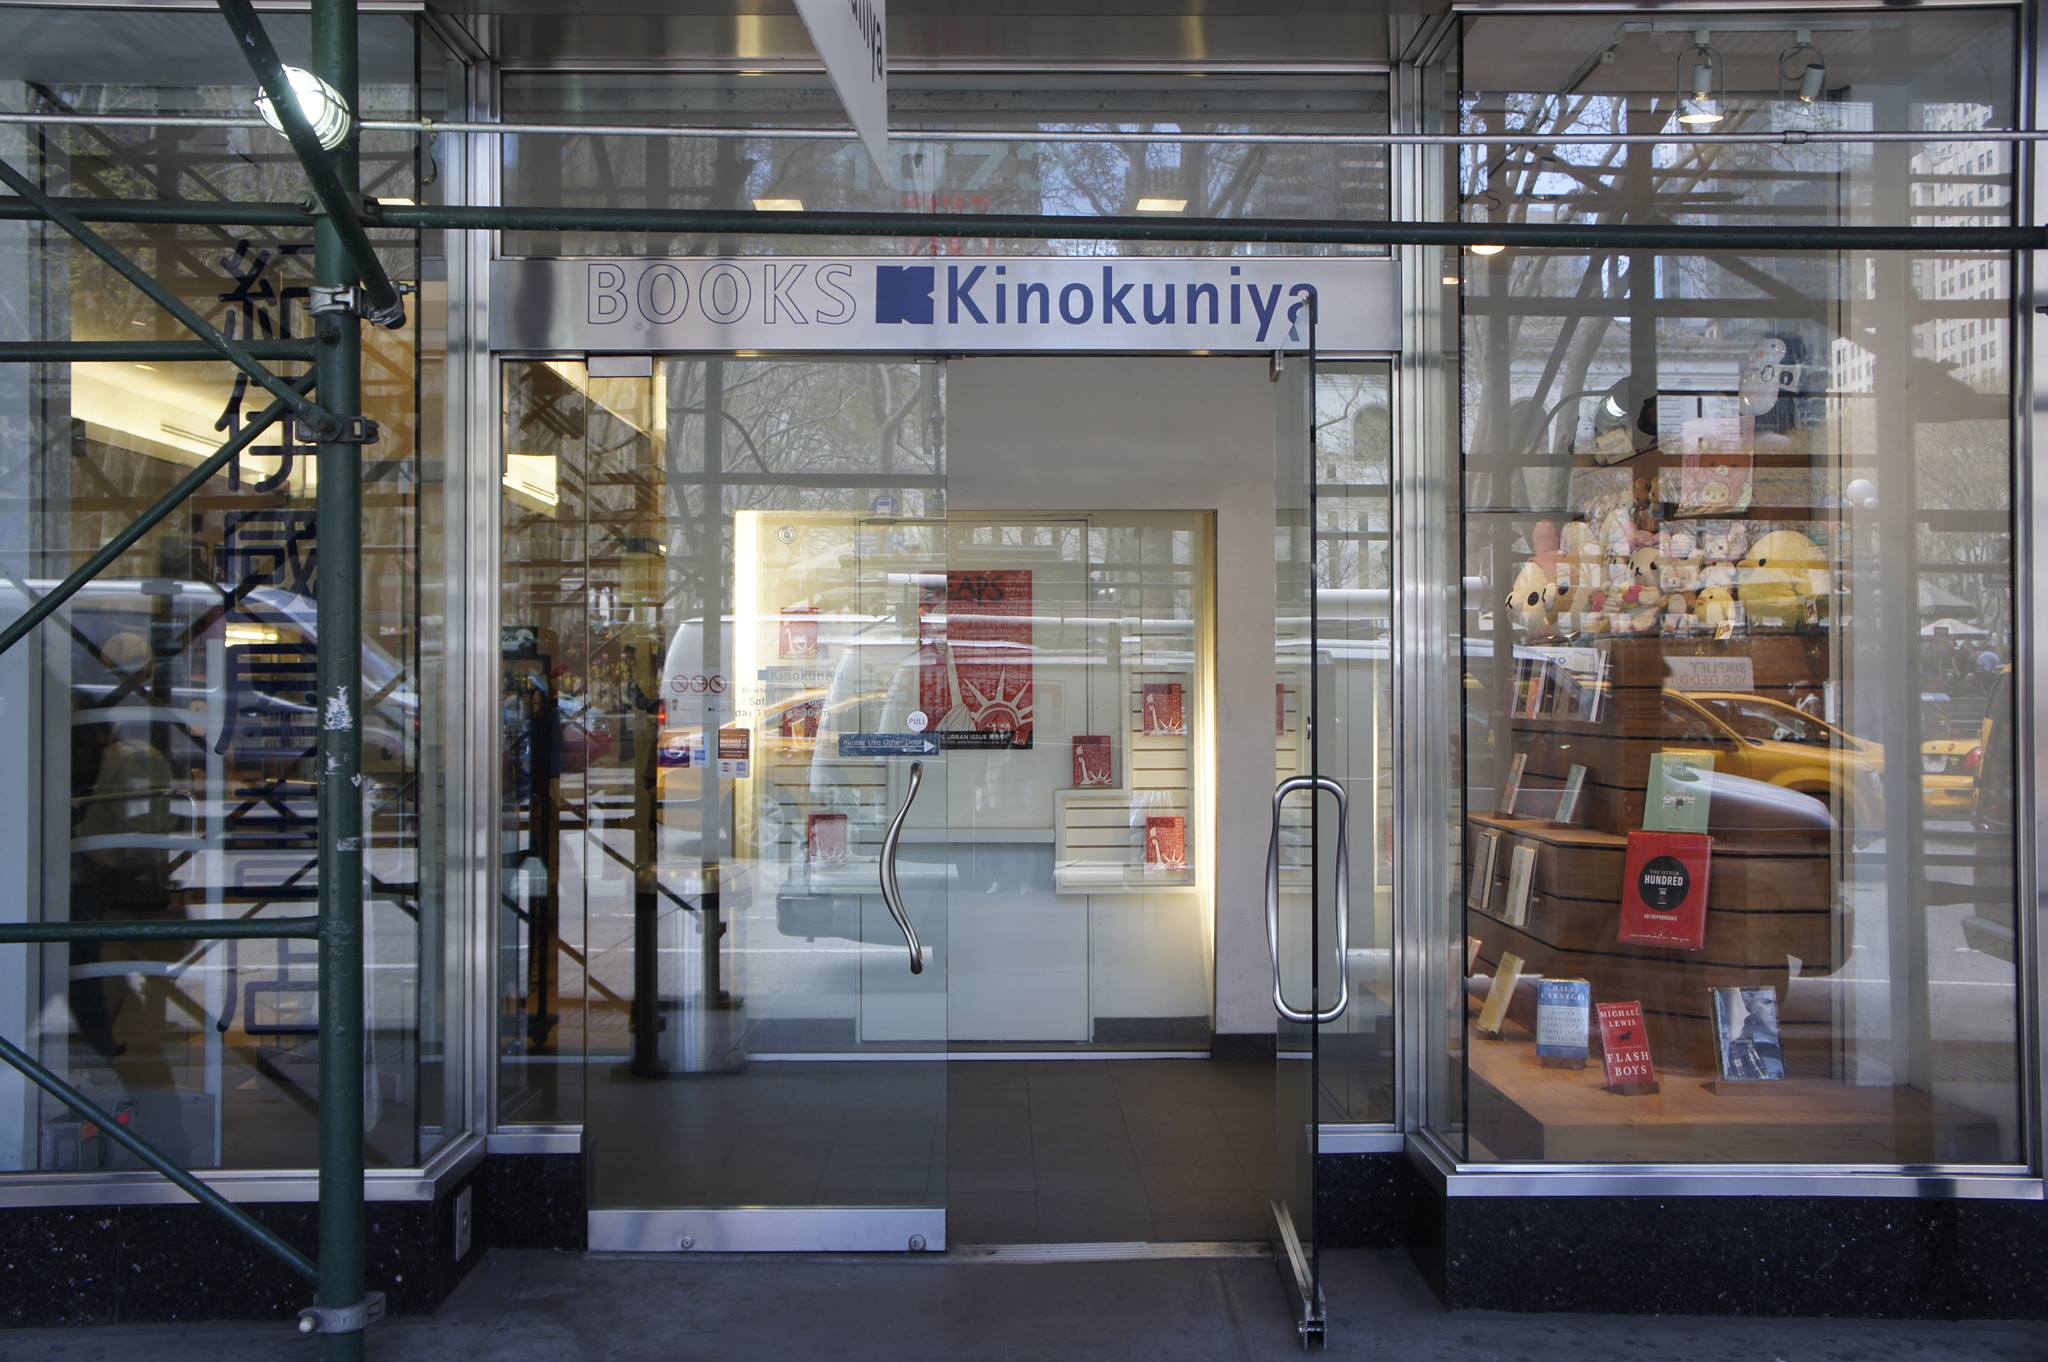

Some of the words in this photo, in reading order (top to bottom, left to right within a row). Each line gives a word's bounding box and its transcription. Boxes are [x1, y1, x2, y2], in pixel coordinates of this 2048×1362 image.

[587, 263, 857, 325] BOOKS
[947, 265, 1319, 342] Kinokuniya
[908, 717, 926, 726] PULL
[867, 739, 881, 747] Use
[883, 738, 903, 747] Other
[1644, 874, 1684, 887] HUNDRED
[1599, 1009, 1641, 1018] MICHAEL
[1608, 1019, 1637, 1028] LEWIS
[1607, 1051, 1649, 1064] FLASH
[1615, 1065, 1648, 1077] BOYS
